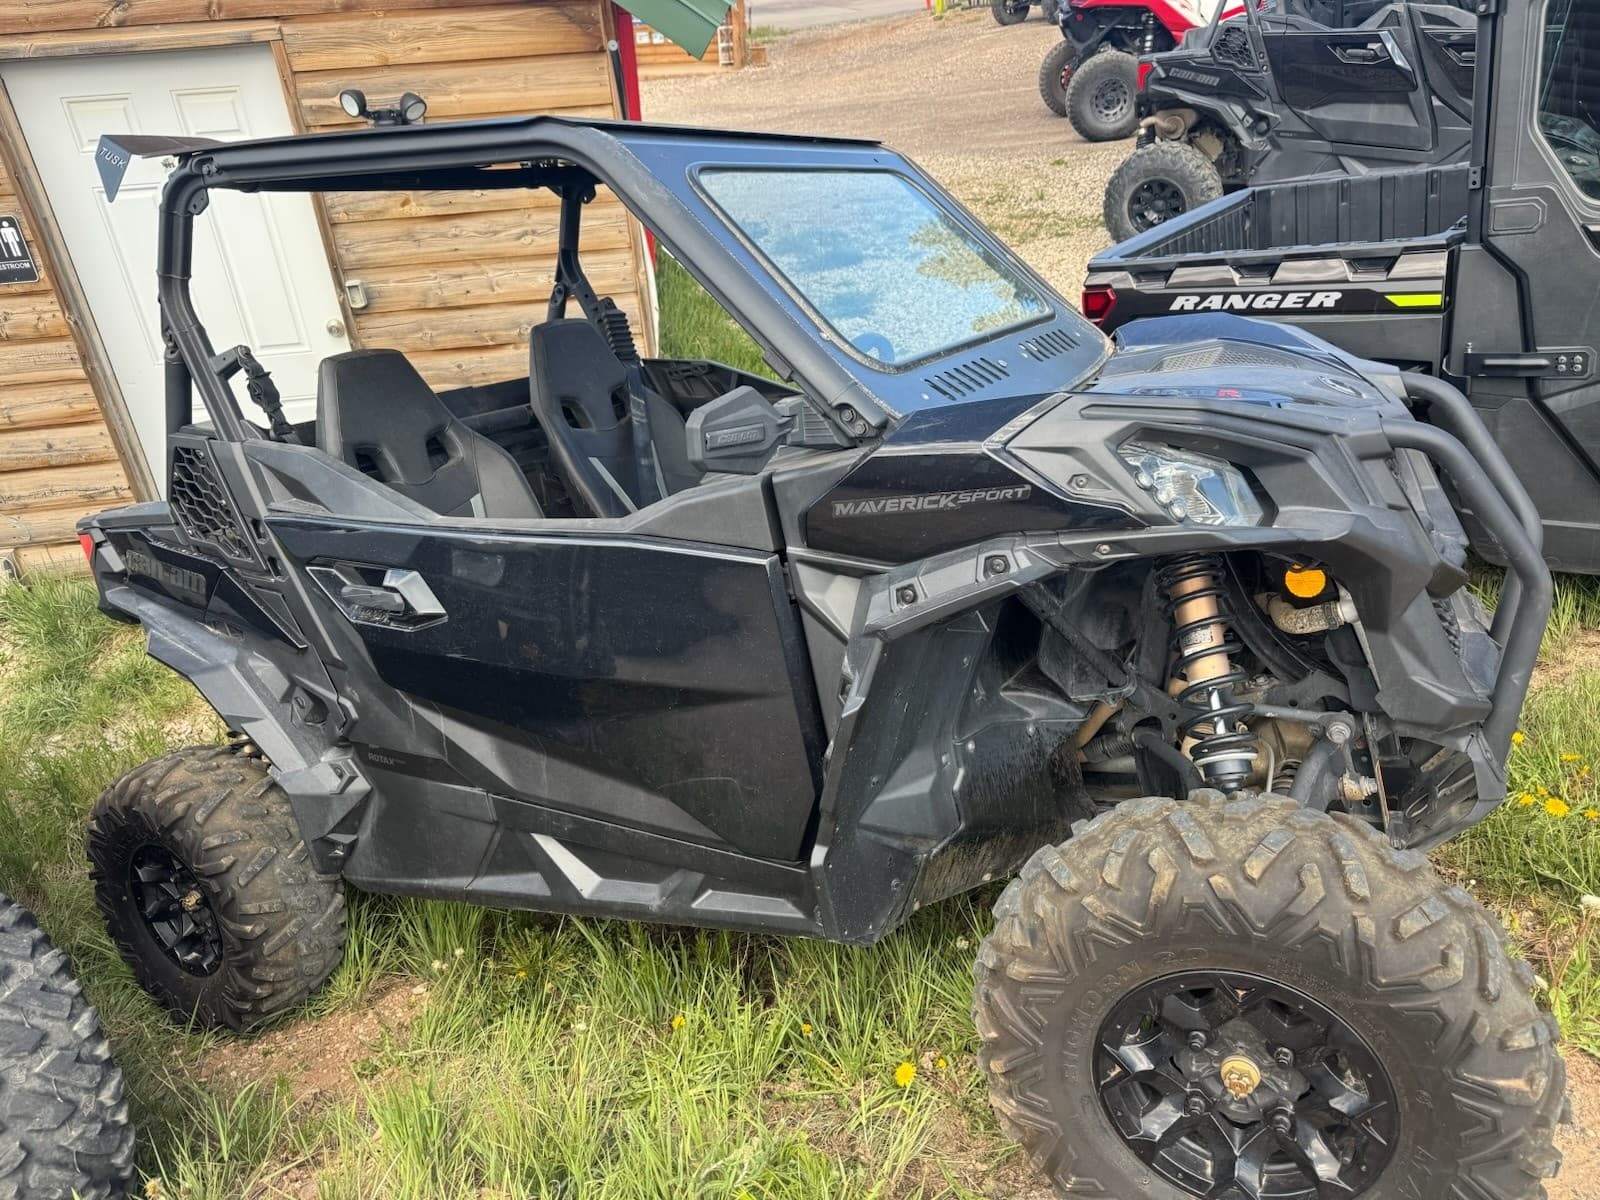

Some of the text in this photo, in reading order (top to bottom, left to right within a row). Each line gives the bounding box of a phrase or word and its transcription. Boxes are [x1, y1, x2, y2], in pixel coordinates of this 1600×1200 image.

[100, 147, 127, 168] TUSK
[0, 263, 30, 271] ESTROOM
[1169, 291, 1343, 311] RANGER
[834, 485, 1030, 515] MAVERICK SPORT
